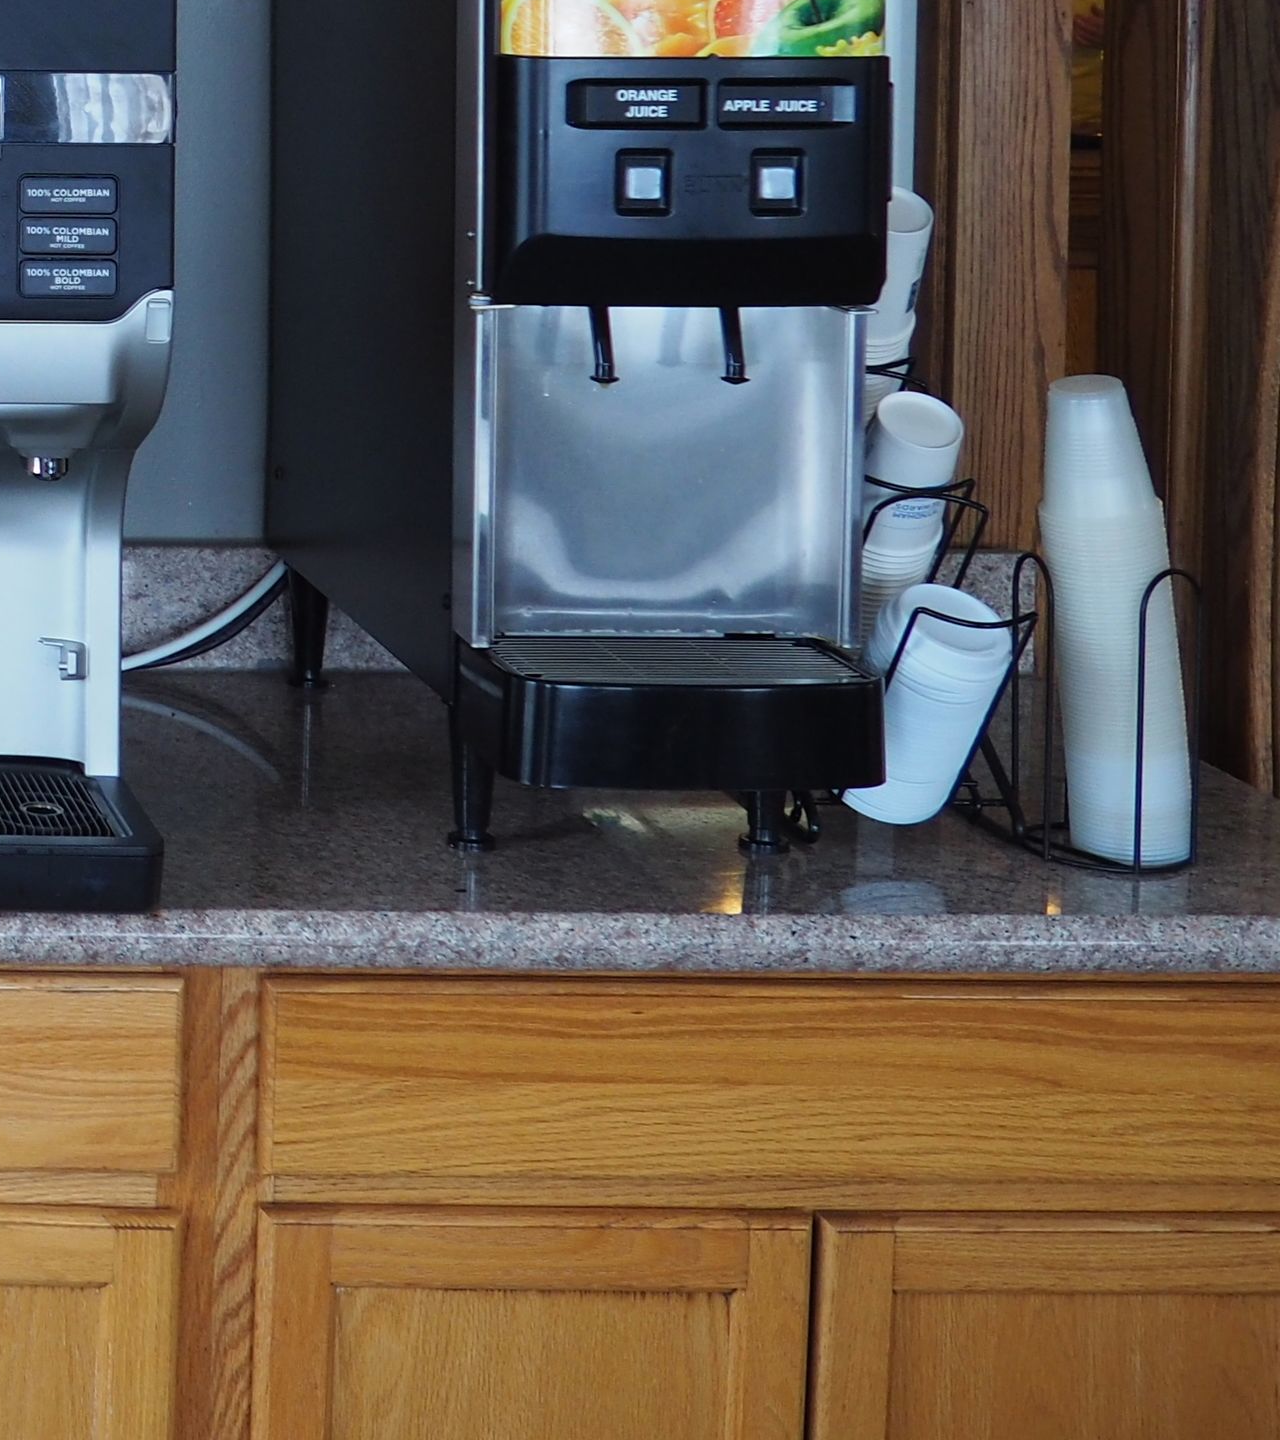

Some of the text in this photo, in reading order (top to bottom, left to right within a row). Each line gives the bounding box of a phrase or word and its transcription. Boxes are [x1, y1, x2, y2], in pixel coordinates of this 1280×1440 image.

[616, 89, 678, 102] ORANGE
[723, 100, 818, 112] APPLE JUICE
[625, 105, 668, 118] JUICE
[26, 188, 110, 197] 100% COLOMBIAN
[26, 226, 110, 236] 100% COLOMBIAN
[55, 235, 79, 243] MILD
[26, 268, 110, 277] 100% COLOMBIAN
[54, 277, 81, 285] BOLD
